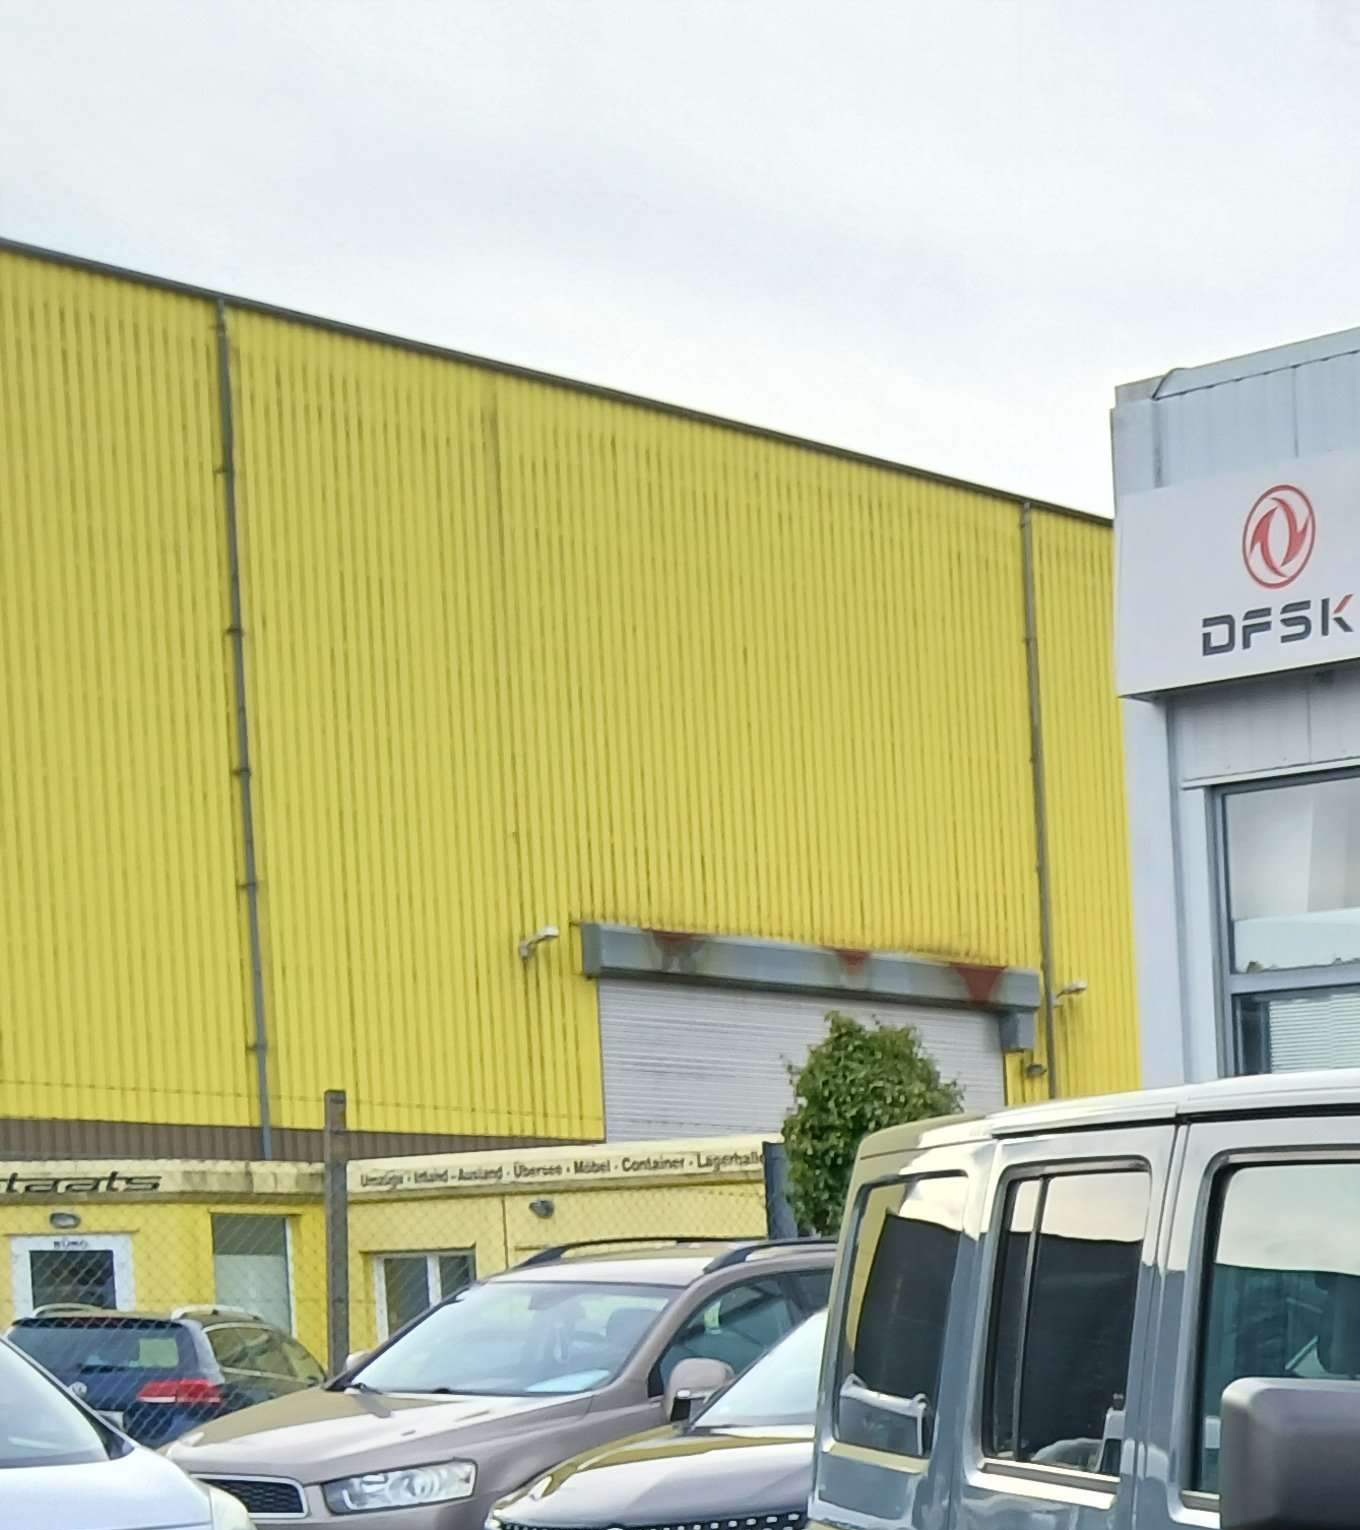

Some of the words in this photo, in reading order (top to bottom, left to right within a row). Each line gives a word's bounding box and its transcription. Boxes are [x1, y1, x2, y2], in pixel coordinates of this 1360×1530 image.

[1203, 594, 1354, 657] DFSK
[622, 1155, 685, 1173] Container
[0, 1171, 162, 1194] taats
